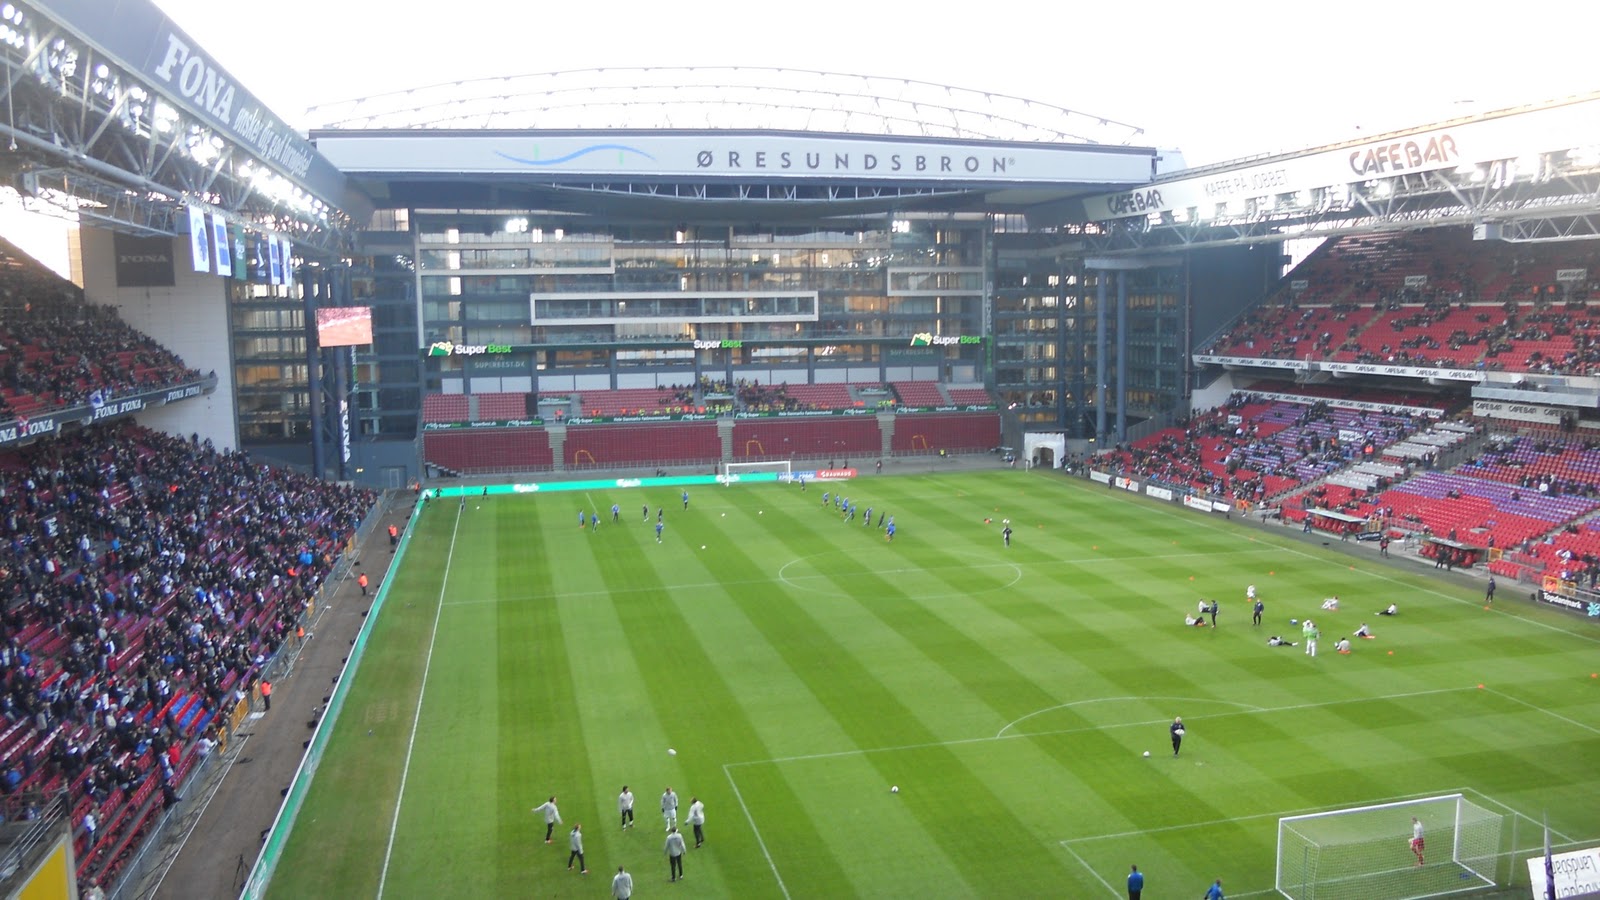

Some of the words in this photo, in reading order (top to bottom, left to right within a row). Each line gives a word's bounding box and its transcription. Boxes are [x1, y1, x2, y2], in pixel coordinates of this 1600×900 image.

[155, 32, 235, 125] FONA
[1203, 178, 1233, 198] KAFFE
[1235, 173, 1248, 194] PÅ
[1251, 169, 1288, 191] JOBBET
[120, 254, 168, 264] FONA
[167, 390, 184, 402] FONA
[185, 386, 200, 397] FONA
[94, 404, 118, 420] FONA
[120, 399, 142, 413] FONA
[0, 427, 17, 442] NA
